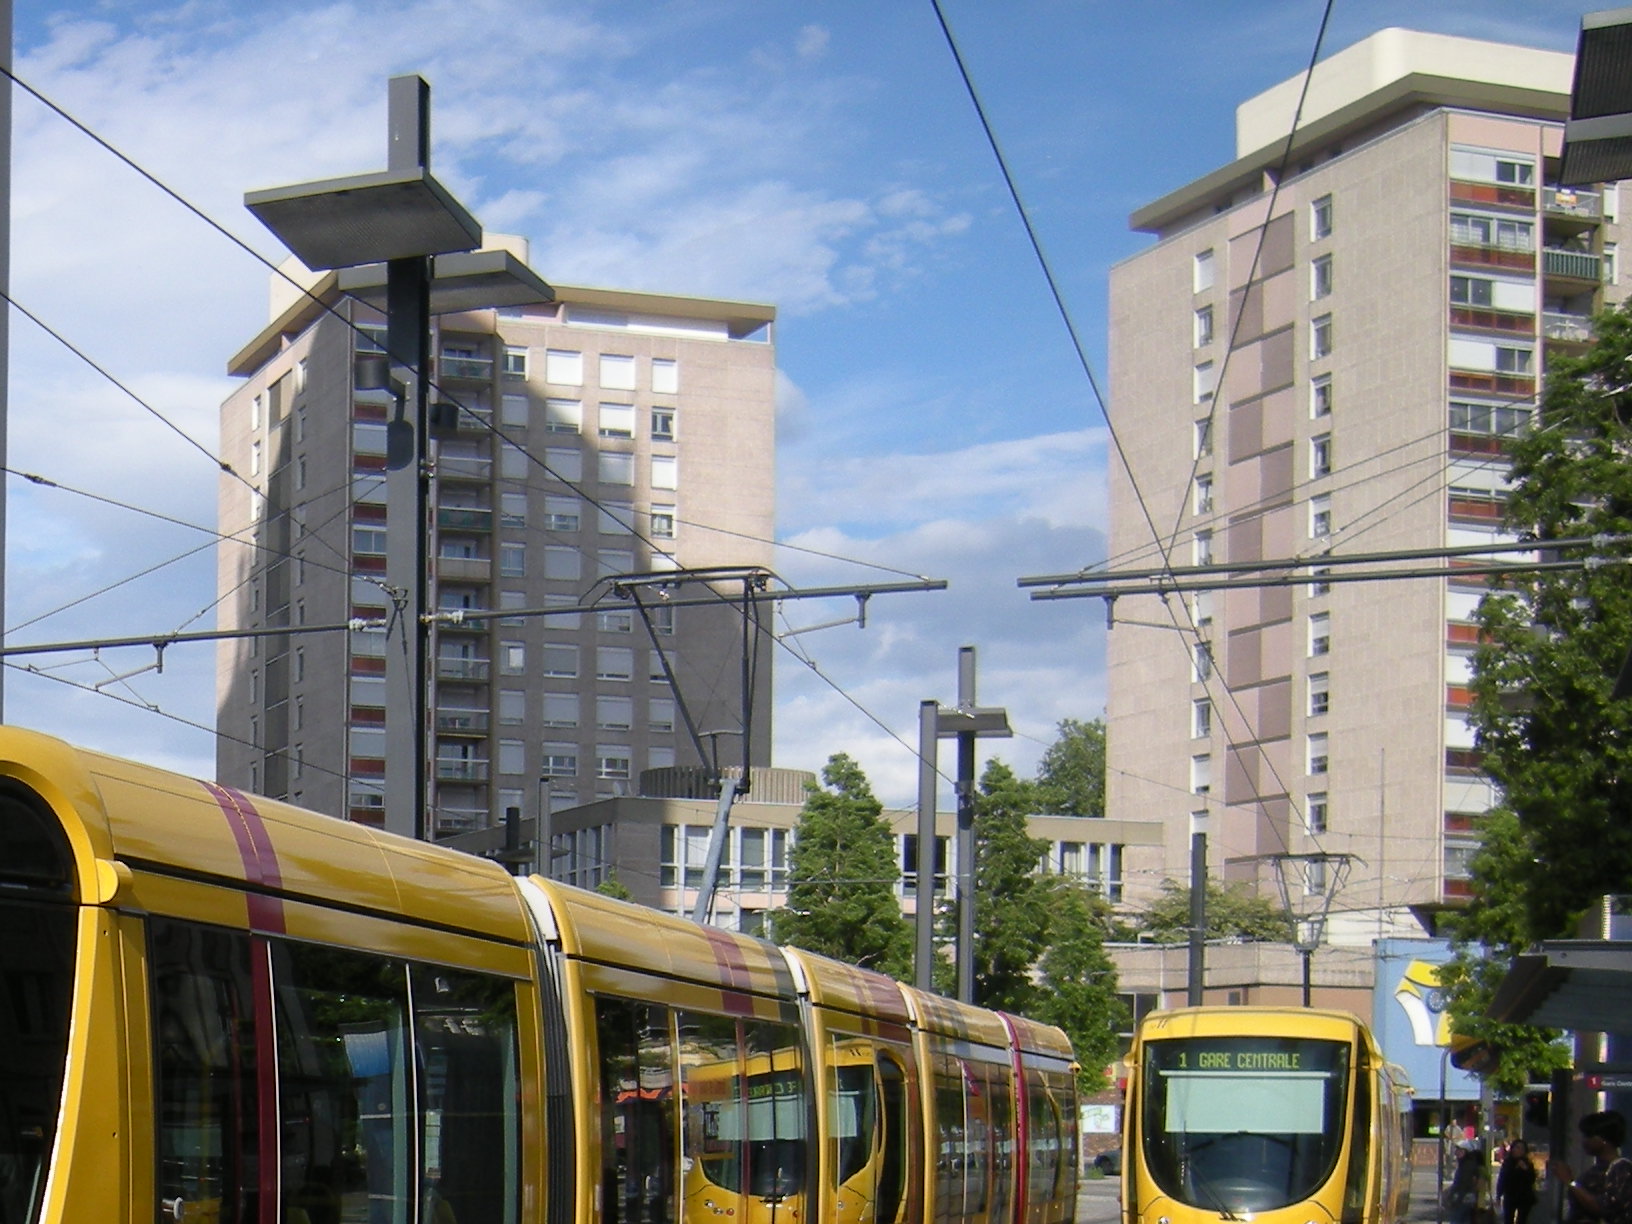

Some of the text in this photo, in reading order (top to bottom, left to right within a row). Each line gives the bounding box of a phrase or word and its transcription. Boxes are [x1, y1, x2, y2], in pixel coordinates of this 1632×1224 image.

[1179, 1052, 1300, 1069] 1 GARE CENTRALE
